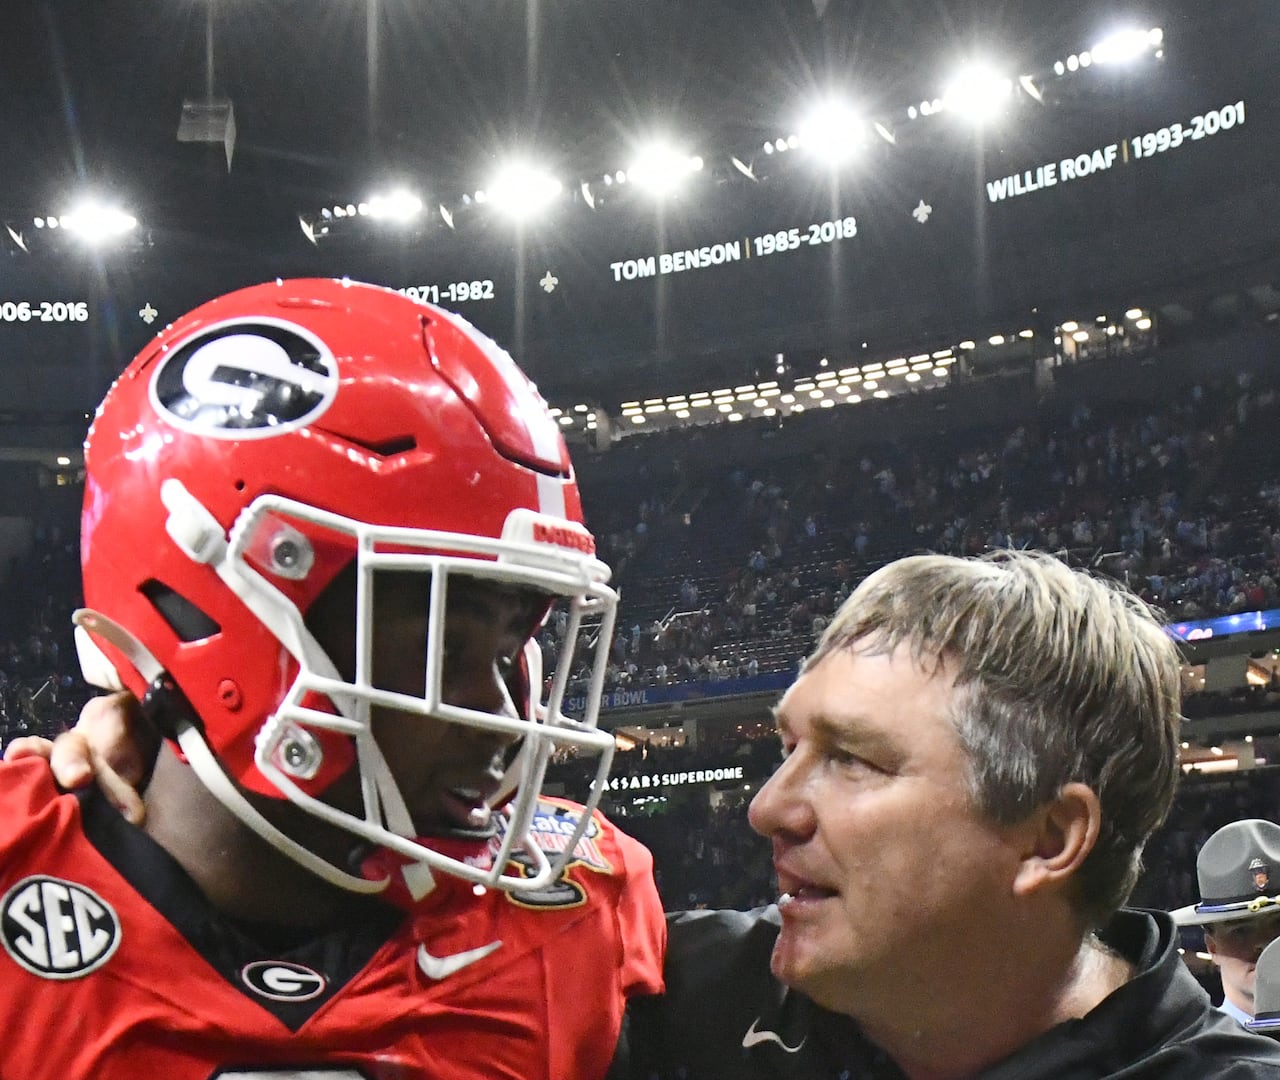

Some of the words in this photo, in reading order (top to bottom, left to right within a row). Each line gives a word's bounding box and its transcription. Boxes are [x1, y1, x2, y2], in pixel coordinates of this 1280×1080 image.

[986, 163, 1058, 202] WILLIE
[1060, 145, 1118, 182] ROAF
[1131, 101, 1246, 160] 1993-2001
[610, 259, 656, 282] TOM
[659, 240, 741, 274] BENSON
[753, 216, 858, 257] 1985-2018
[567, 694, 610, 711] SUR
[613, 690, 649, 707] BOWL
[662, 767, 744, 786] SUPERDOME
[7, 881, 111, 969] SEC
